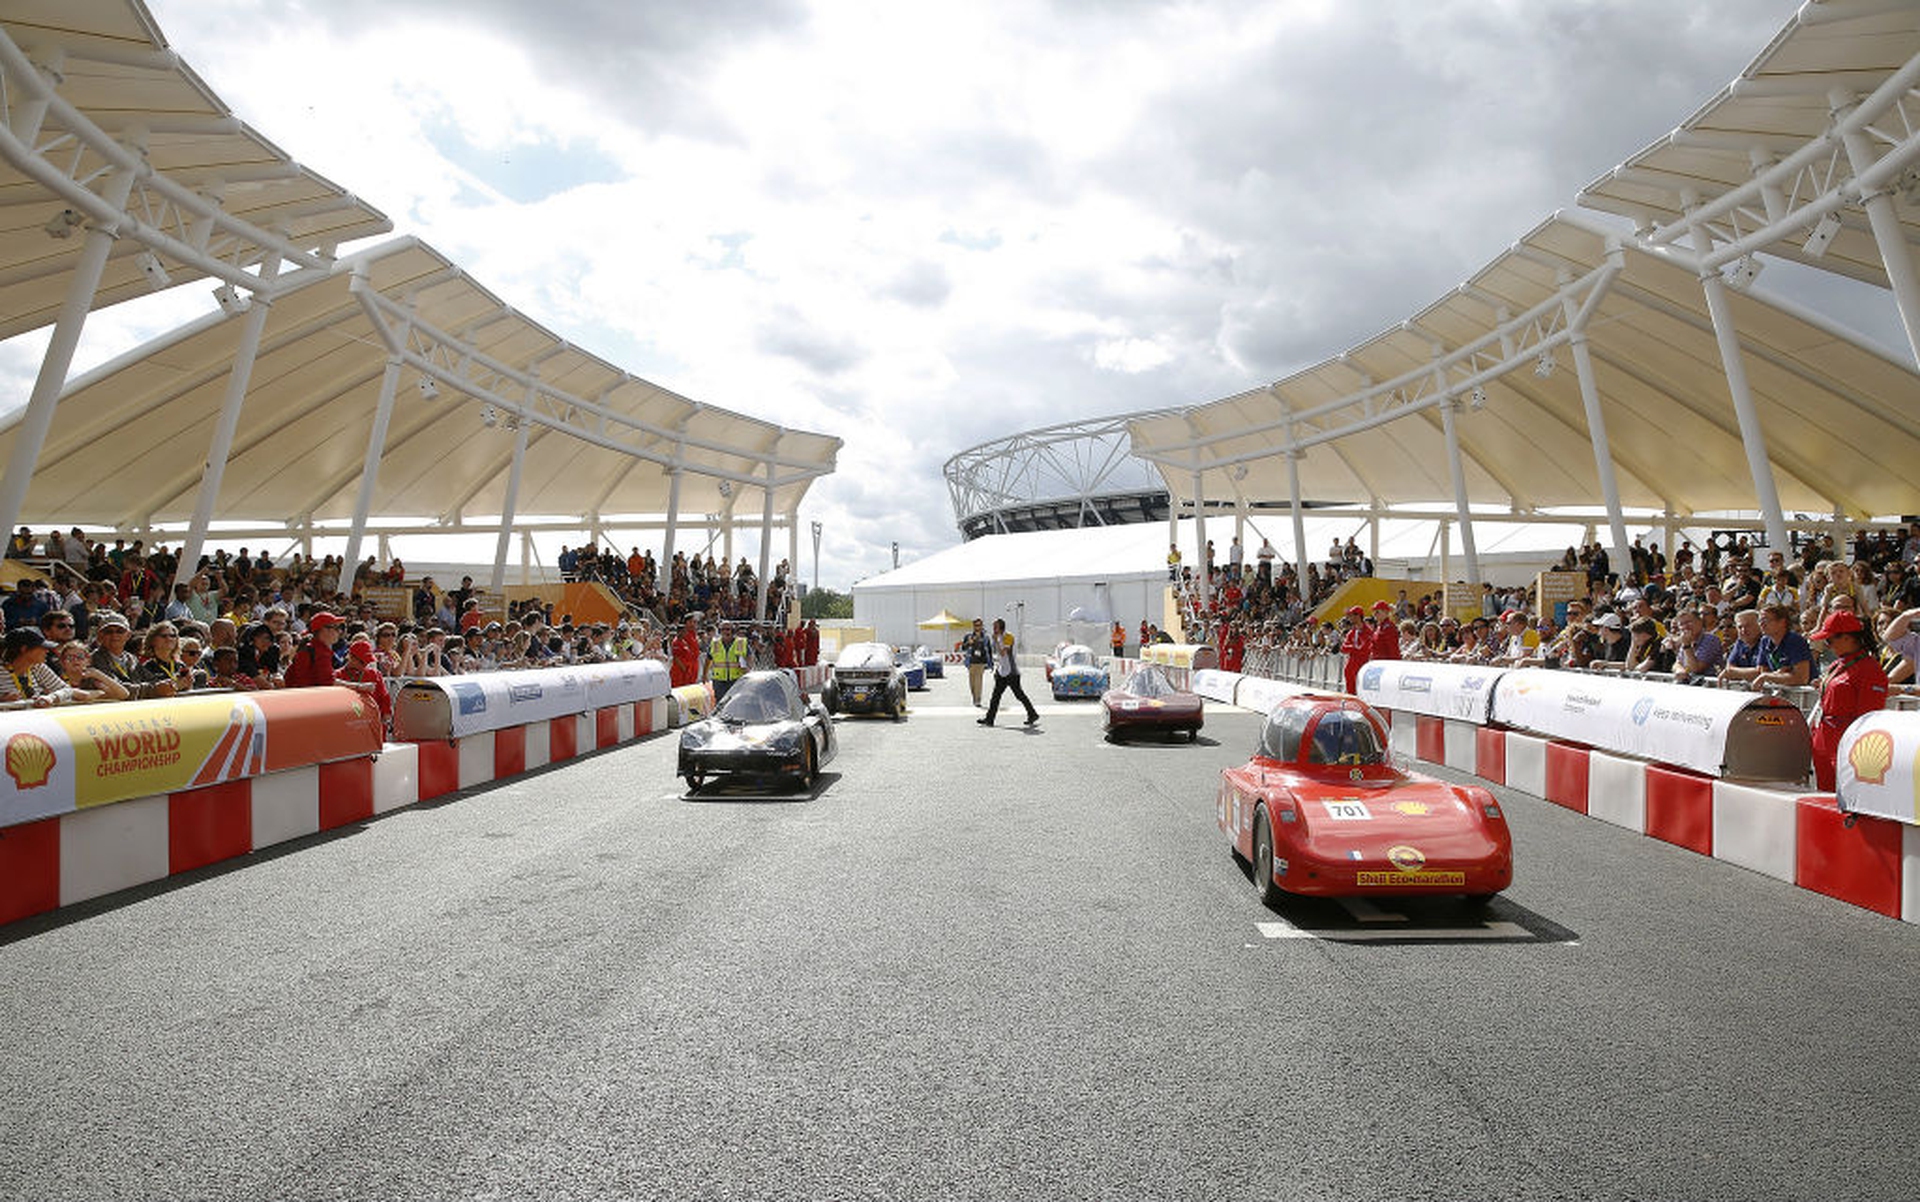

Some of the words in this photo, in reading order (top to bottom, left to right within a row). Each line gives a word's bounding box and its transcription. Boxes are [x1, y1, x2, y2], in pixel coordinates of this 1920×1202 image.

[94, 726, 181, 761] WORLD
[96, 751, 181, 778] CHAMPIONSHIP
[1331, 804, 1365, 817] 701
[1360, 873, 1387, 884] Shell
